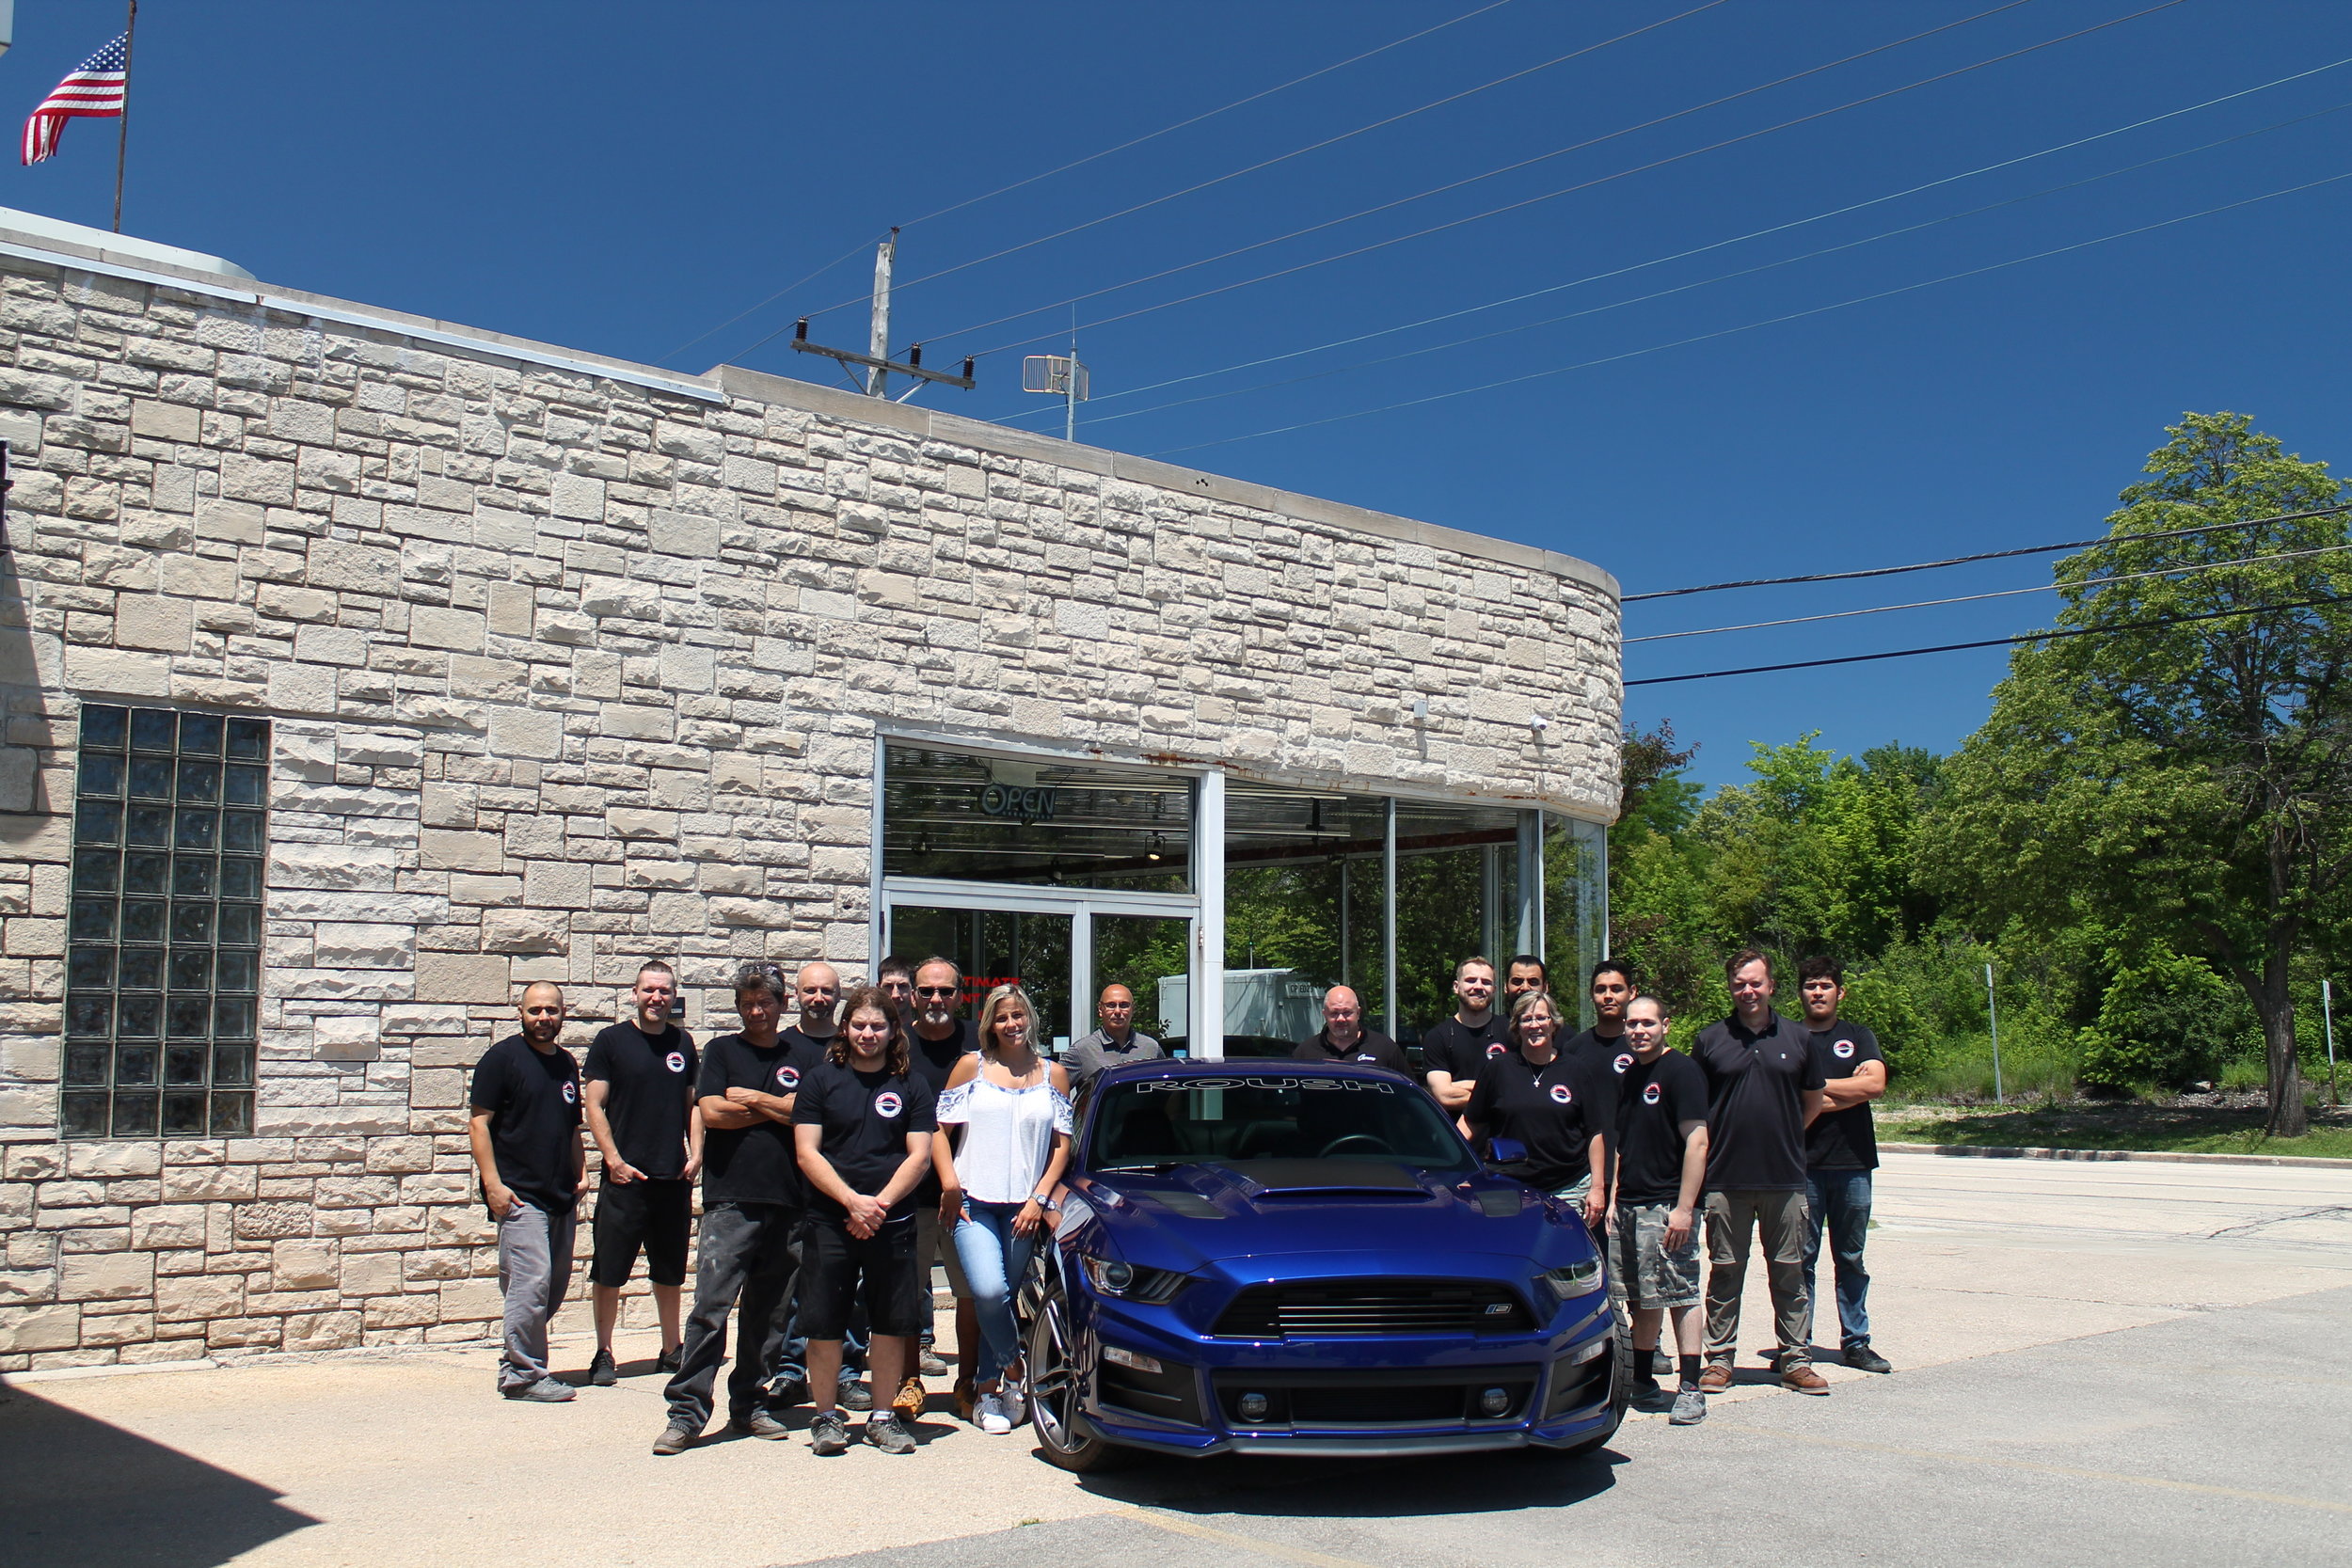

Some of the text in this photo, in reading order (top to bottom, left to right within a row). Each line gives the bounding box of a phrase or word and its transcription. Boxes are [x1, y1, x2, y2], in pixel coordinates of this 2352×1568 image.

[981, 784, 1056, 815] OPEN
[961, 976, 1022, 987] TIMATE
[1136, 1078, 1394, 1094] ROUSH
